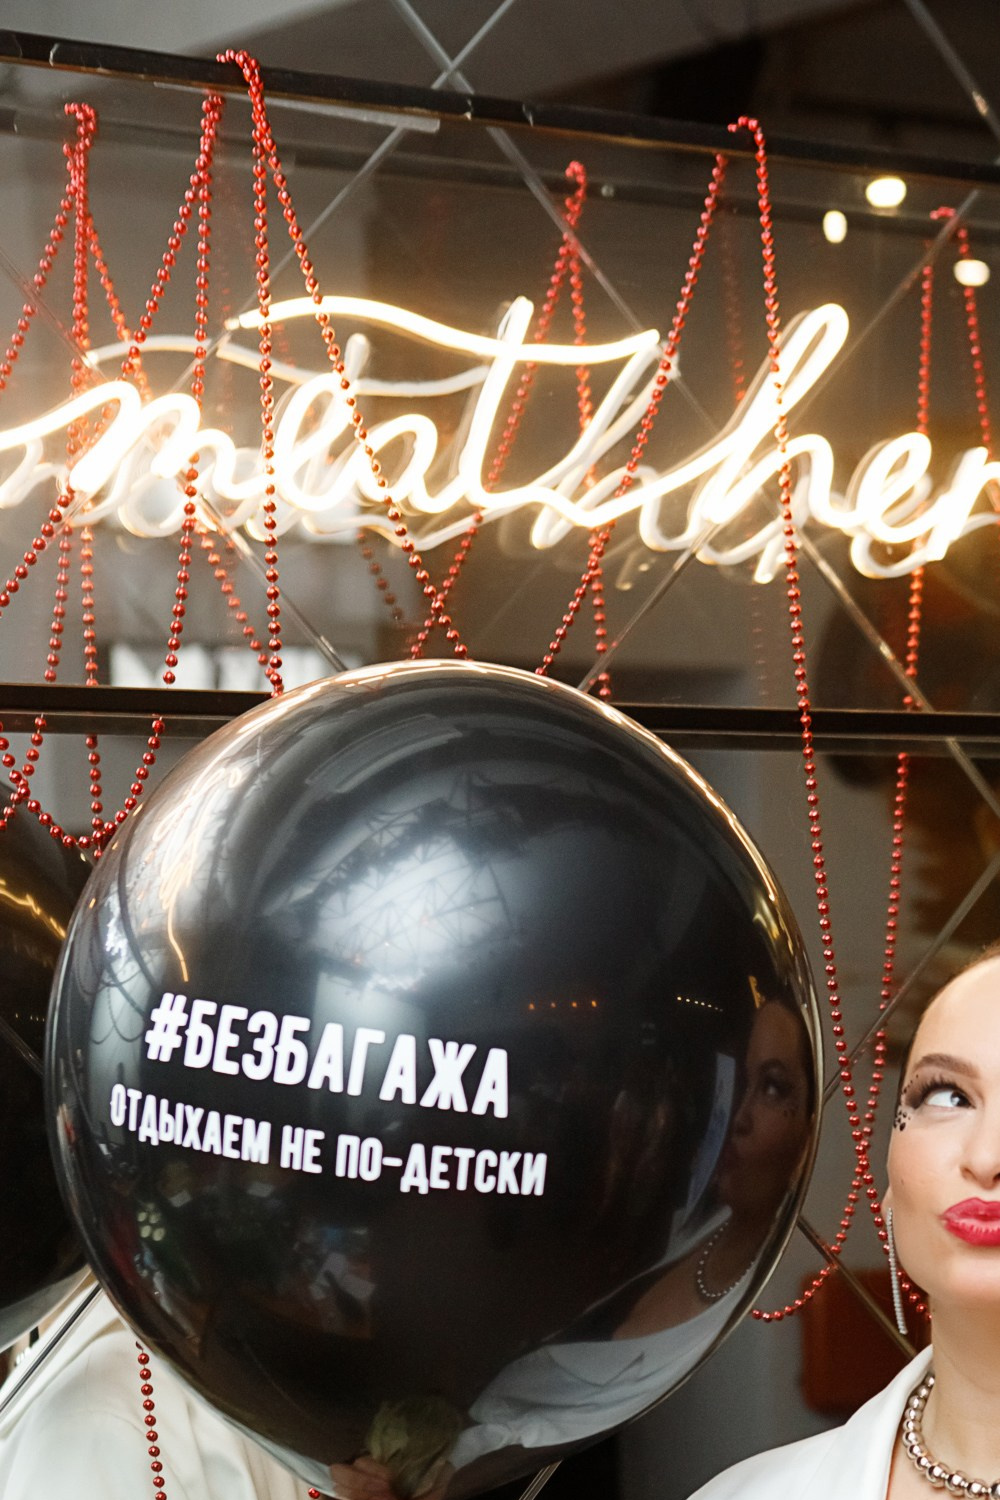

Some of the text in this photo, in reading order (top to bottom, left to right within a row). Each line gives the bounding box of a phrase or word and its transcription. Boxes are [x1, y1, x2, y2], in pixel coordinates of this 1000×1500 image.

[145, 992, 509, 1118] #БЕЗБАГАЖА
[110, 1083, 548, 1197] ОТДЫХАЕМ НЕ ПО-ДЕТСКИ
